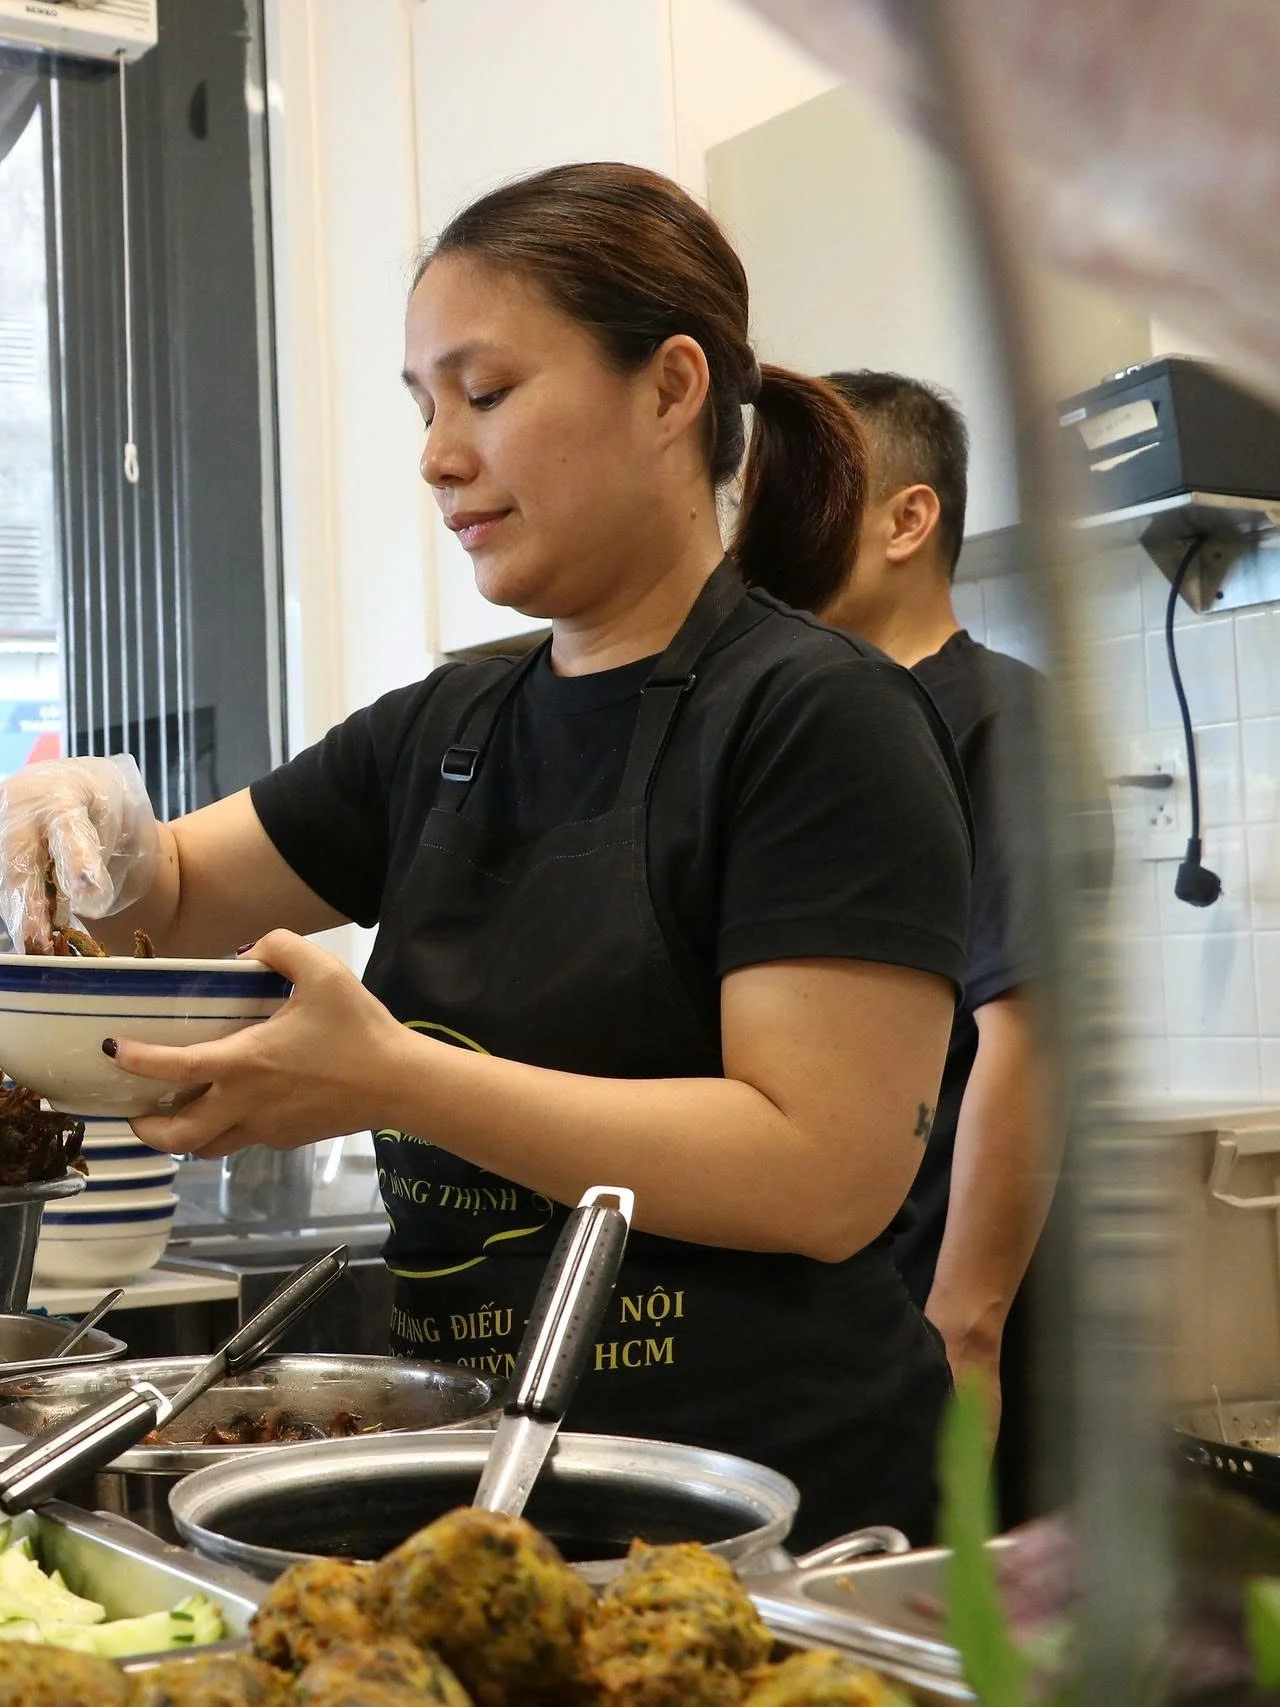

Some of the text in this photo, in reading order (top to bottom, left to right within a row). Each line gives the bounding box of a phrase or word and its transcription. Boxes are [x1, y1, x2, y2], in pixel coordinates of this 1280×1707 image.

[450, 1300, 513, 1341] ĐIẾU
[619, 1285, 686, 1328] NỘI
[593, 1336, 675, 1371] HCM
